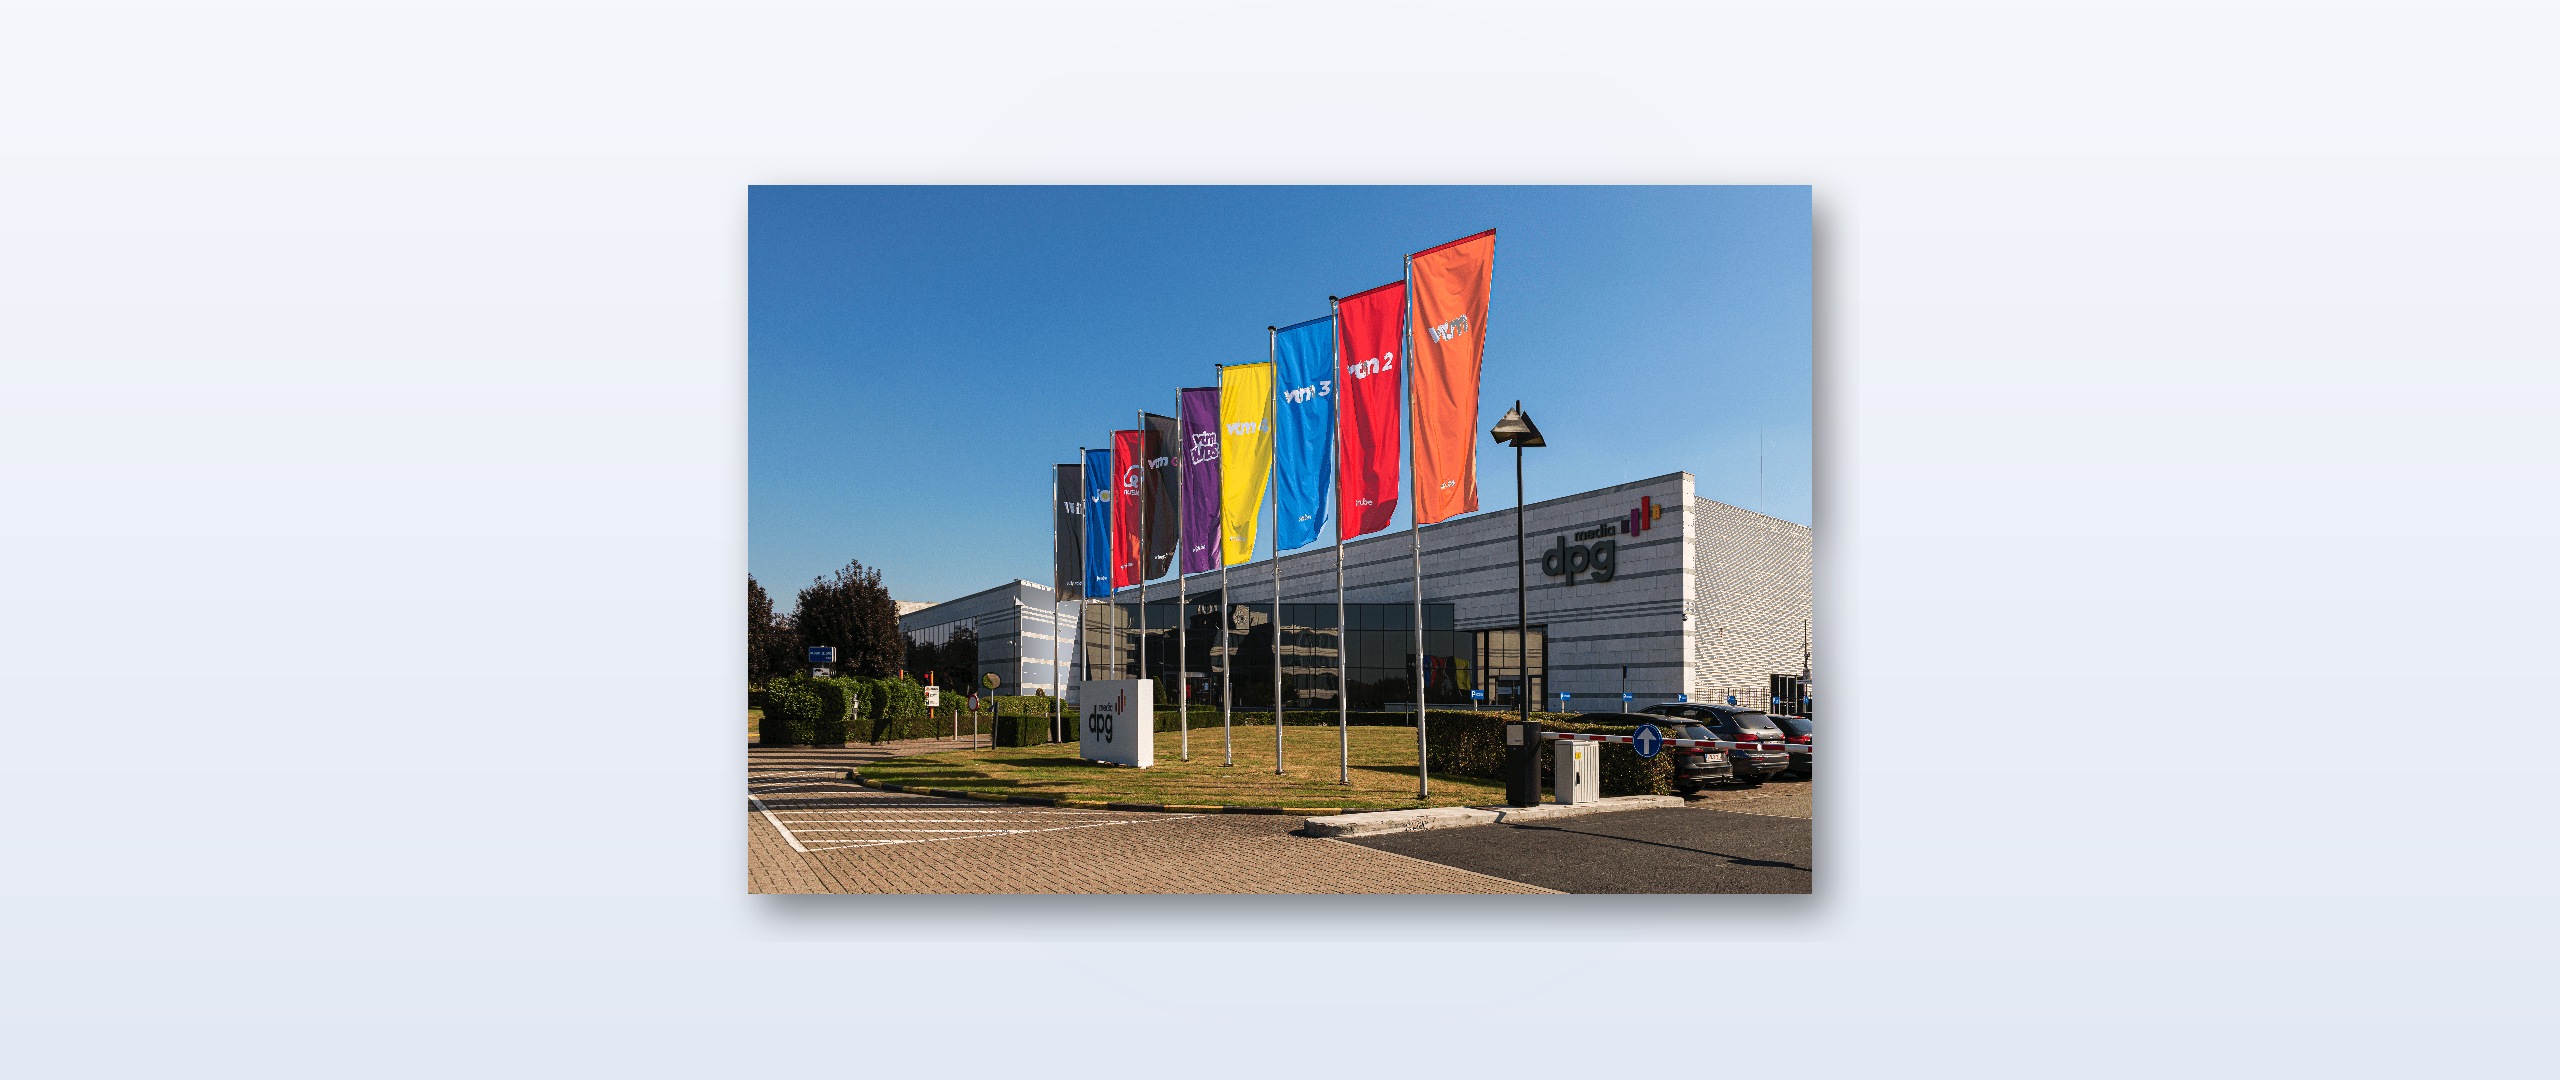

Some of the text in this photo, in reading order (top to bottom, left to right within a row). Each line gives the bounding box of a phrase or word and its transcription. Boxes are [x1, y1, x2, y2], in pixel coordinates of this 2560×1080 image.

[1429, 314, 1468, 343] vtm
[1347, 352, 1394, 379] vtm 2
[1284, 380, 1331, 404] vtm 3
[1192, 430, 1217, 447] vtm
[1226, 421, 1256, 436] vtm
[1147, 456, 1169, 470] vtm
[1574, 524, 1616, 541] media
[1542, 536, 1615, 587] dpg
[1098, 703, 1113, 712] media
[1088, 704, 1113, 744] dpg
